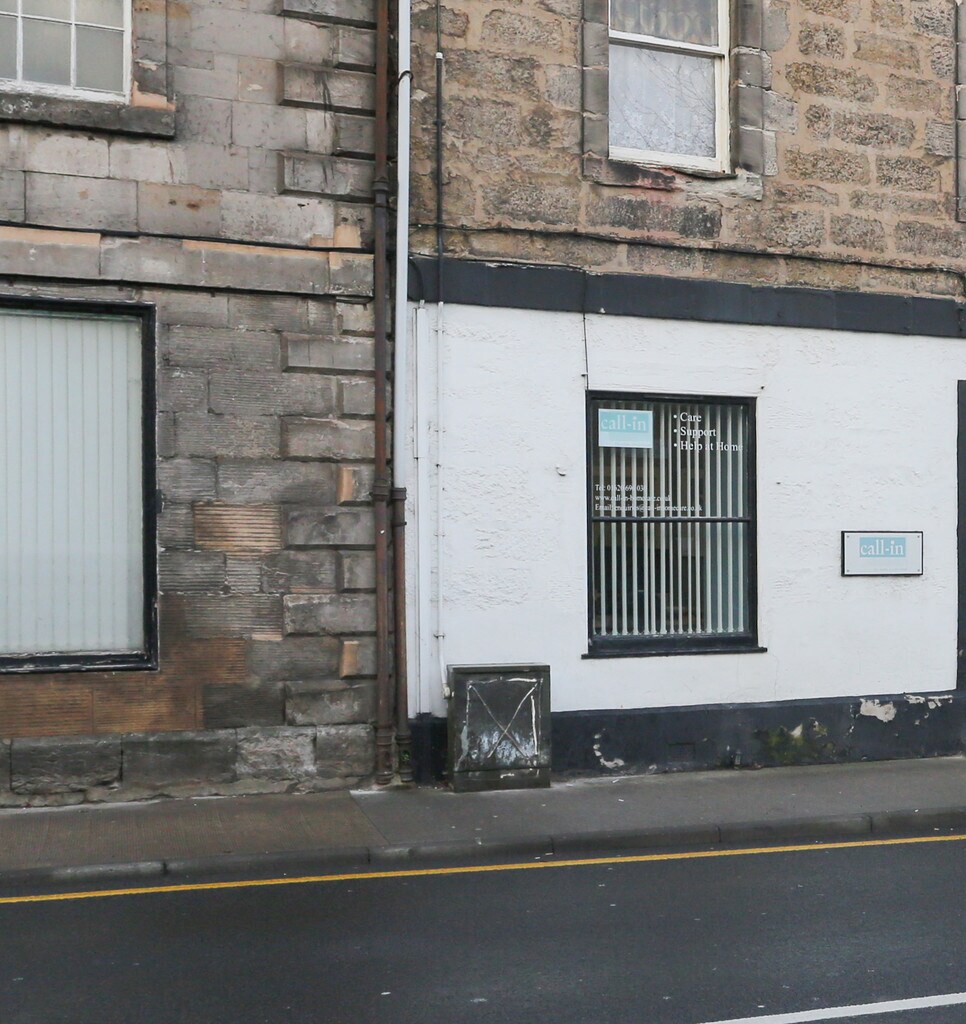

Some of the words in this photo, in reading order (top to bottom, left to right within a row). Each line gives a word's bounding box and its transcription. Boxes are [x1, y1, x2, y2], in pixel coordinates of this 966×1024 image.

[600, 414, 647, 432] call-in
[680, 412, 702, 422] Care
[680, 426, 717, 438] Support
[680, 440, 703, 454] Help
[715, 441, 743, 452] Home
[860, 539, 904, 555] call-in
